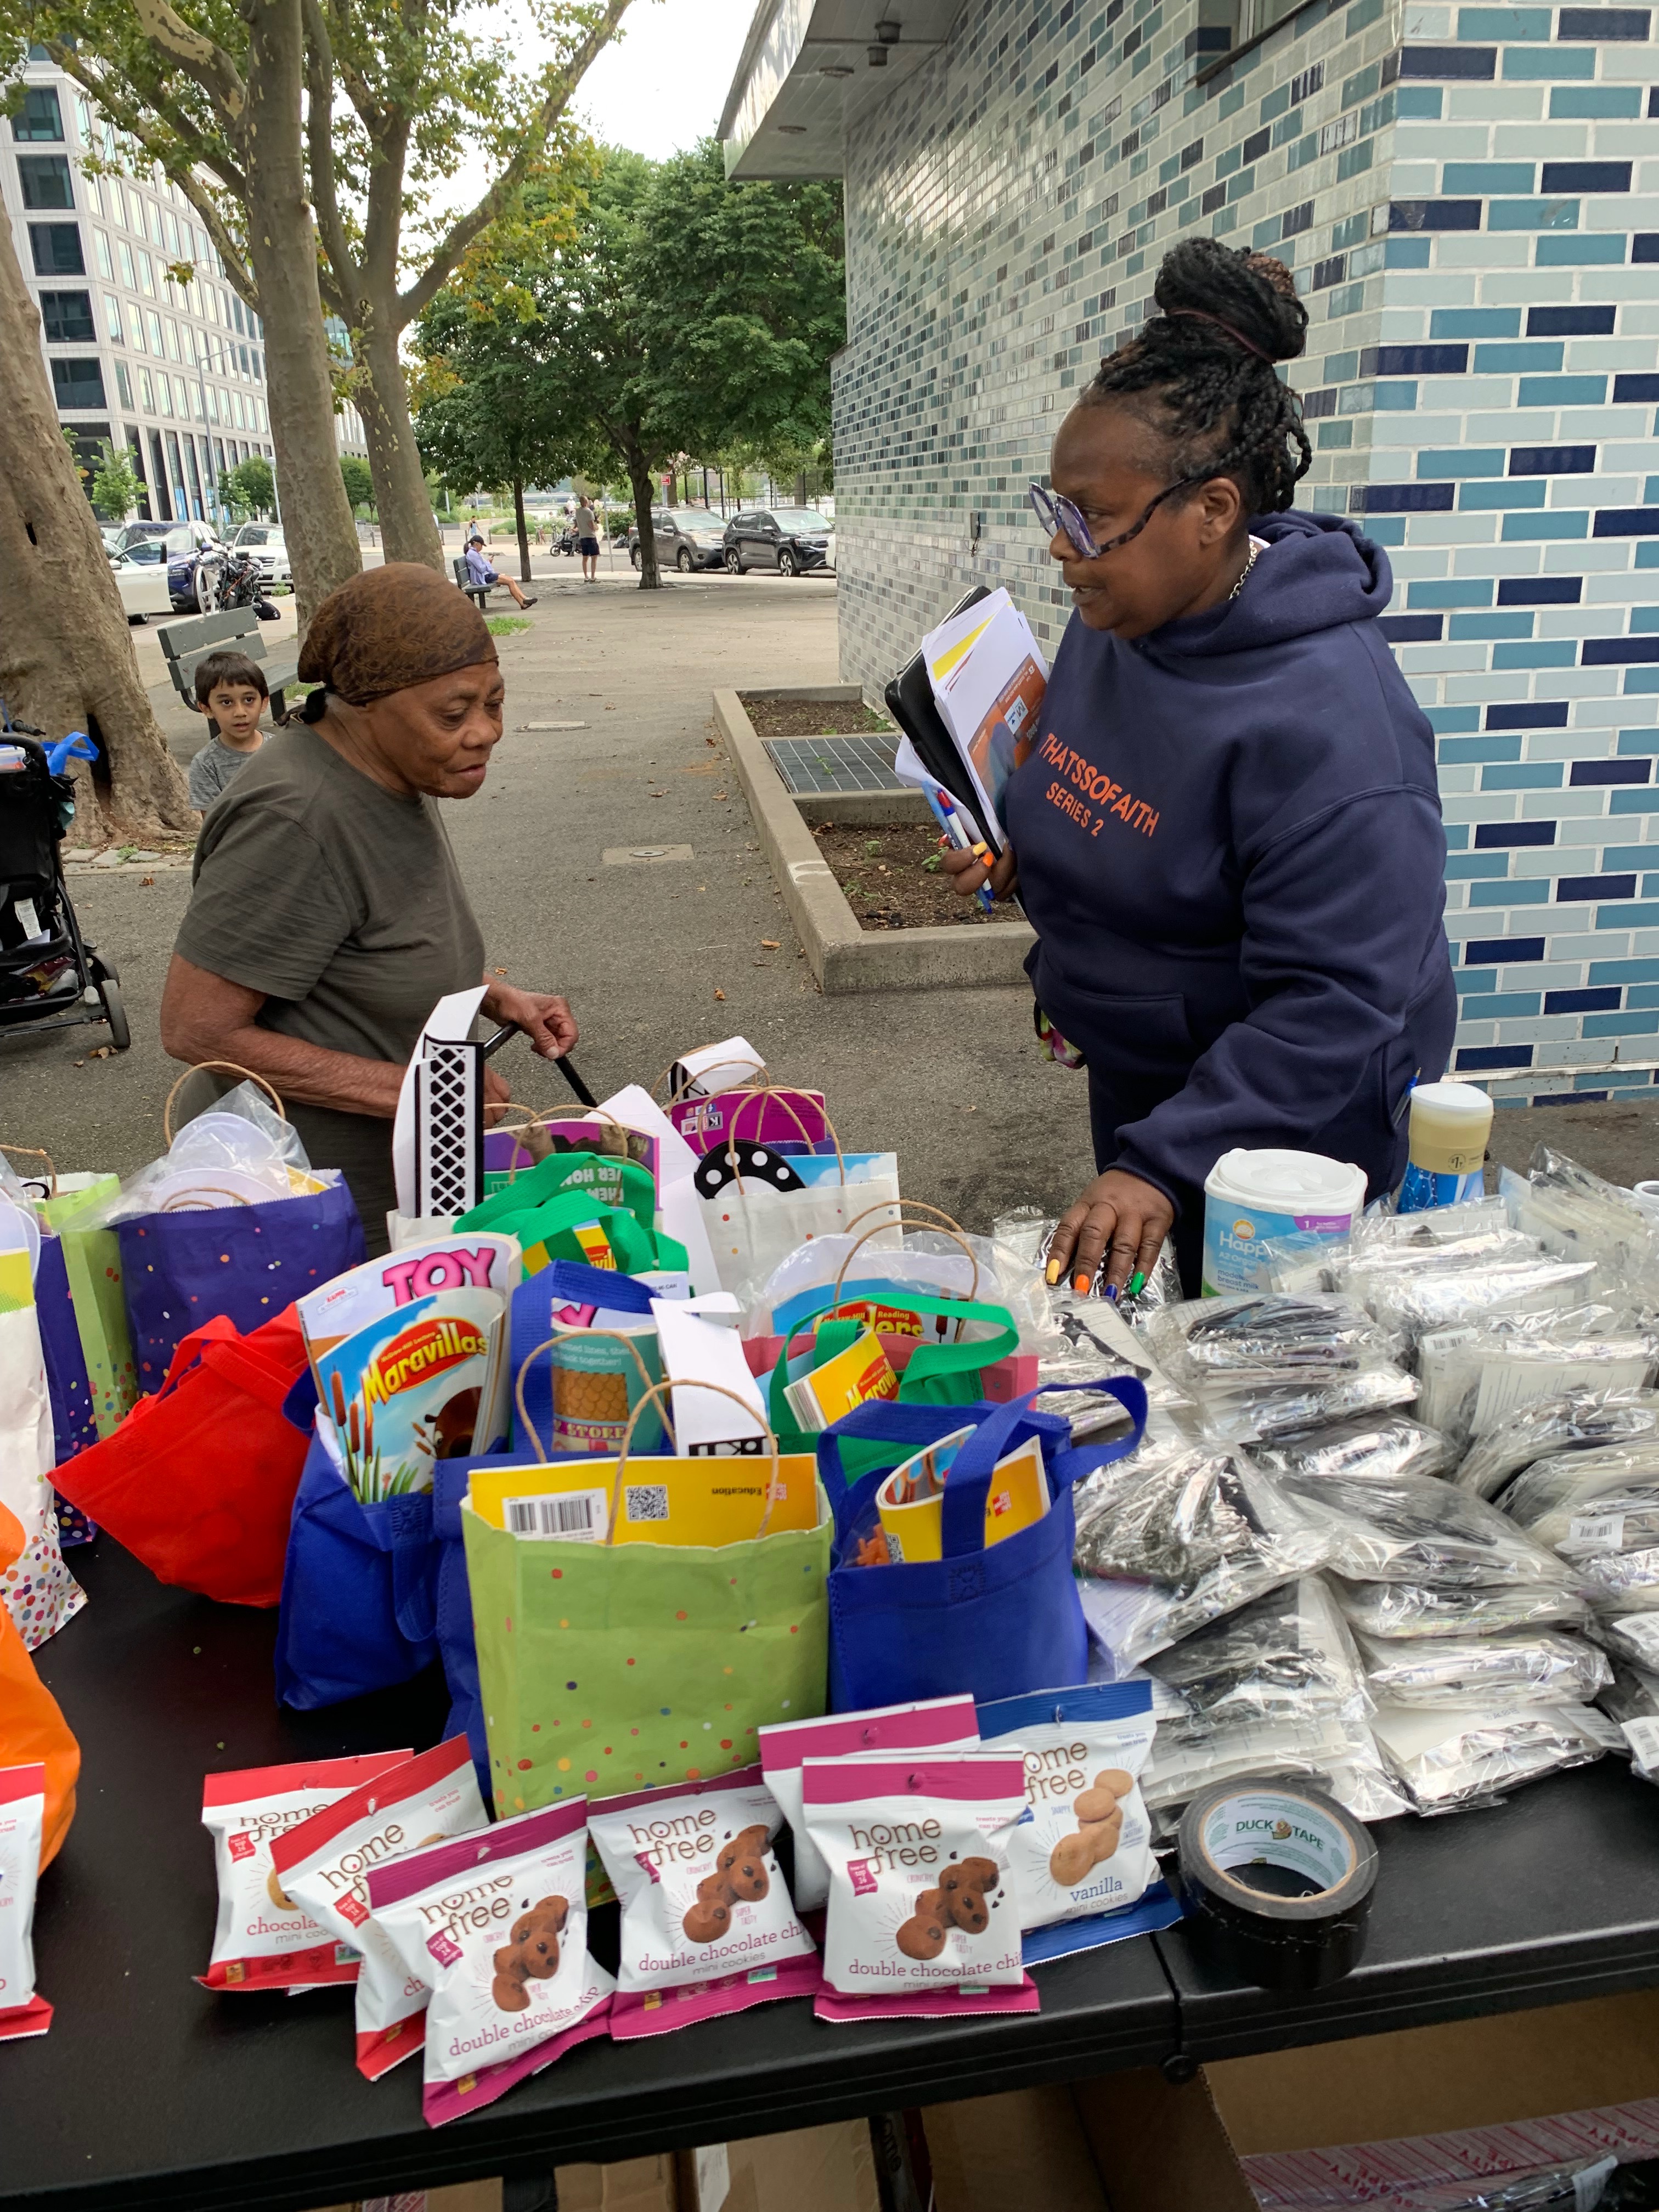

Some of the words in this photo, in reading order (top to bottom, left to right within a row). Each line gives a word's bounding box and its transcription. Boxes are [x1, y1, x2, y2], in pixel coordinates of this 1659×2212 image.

[1039, 732, 1160, 837] THATSSOFAITH
[1046, 782, 1092, 828] SERIES
[1091, 819, 1104, 837] 2
[1304, 1220, 1310, 1229] 1
[382, 1247, 496, 1307] TOY
[1217, 1275, 1242, 1287] breast
[1243, 1280, 1260, 1290] milk
[878, 1311, 910, 1320] Reading
[362, 1322, 488, 1406] Maravillas
[1024, 1742, 1088, 1774] ome
[1027, 1769, 1086, 1804] free
[240, 1803, 329, 1827] home
[627, 1809, 716, 1844] home
[651, 1834, 714, 1866] free
[848, 1818, 942, 1850] home
[1236, 1819, 1274, 1832] DUCK
[1293, 1825, 1325, 1851] TAPE
[317, 1824, 405, 1889] home
[871, 1845, 938, 1875] free
[419, 1875, 514, 1925] home
[1070, 1876, 1123, 1901] vanilla
[1091, 1892, 1128, 1908] cookies
[445, 1897, 510, 1943] free
[275, 1932, 301, 1944] mini
[639, 1953, 696, 1971] double
[699, 1933, 777, 1961] chocolate
[693, 1962, 718, 1975] mini
[721, 1951, 766, 1969] cookies
[849, 1959, 906, 1977] double
[911, 1962, 992, 1977] chocolate
[449, 2024, 510, 2057] double
[513, 2007, 573, 2034] chocolate
